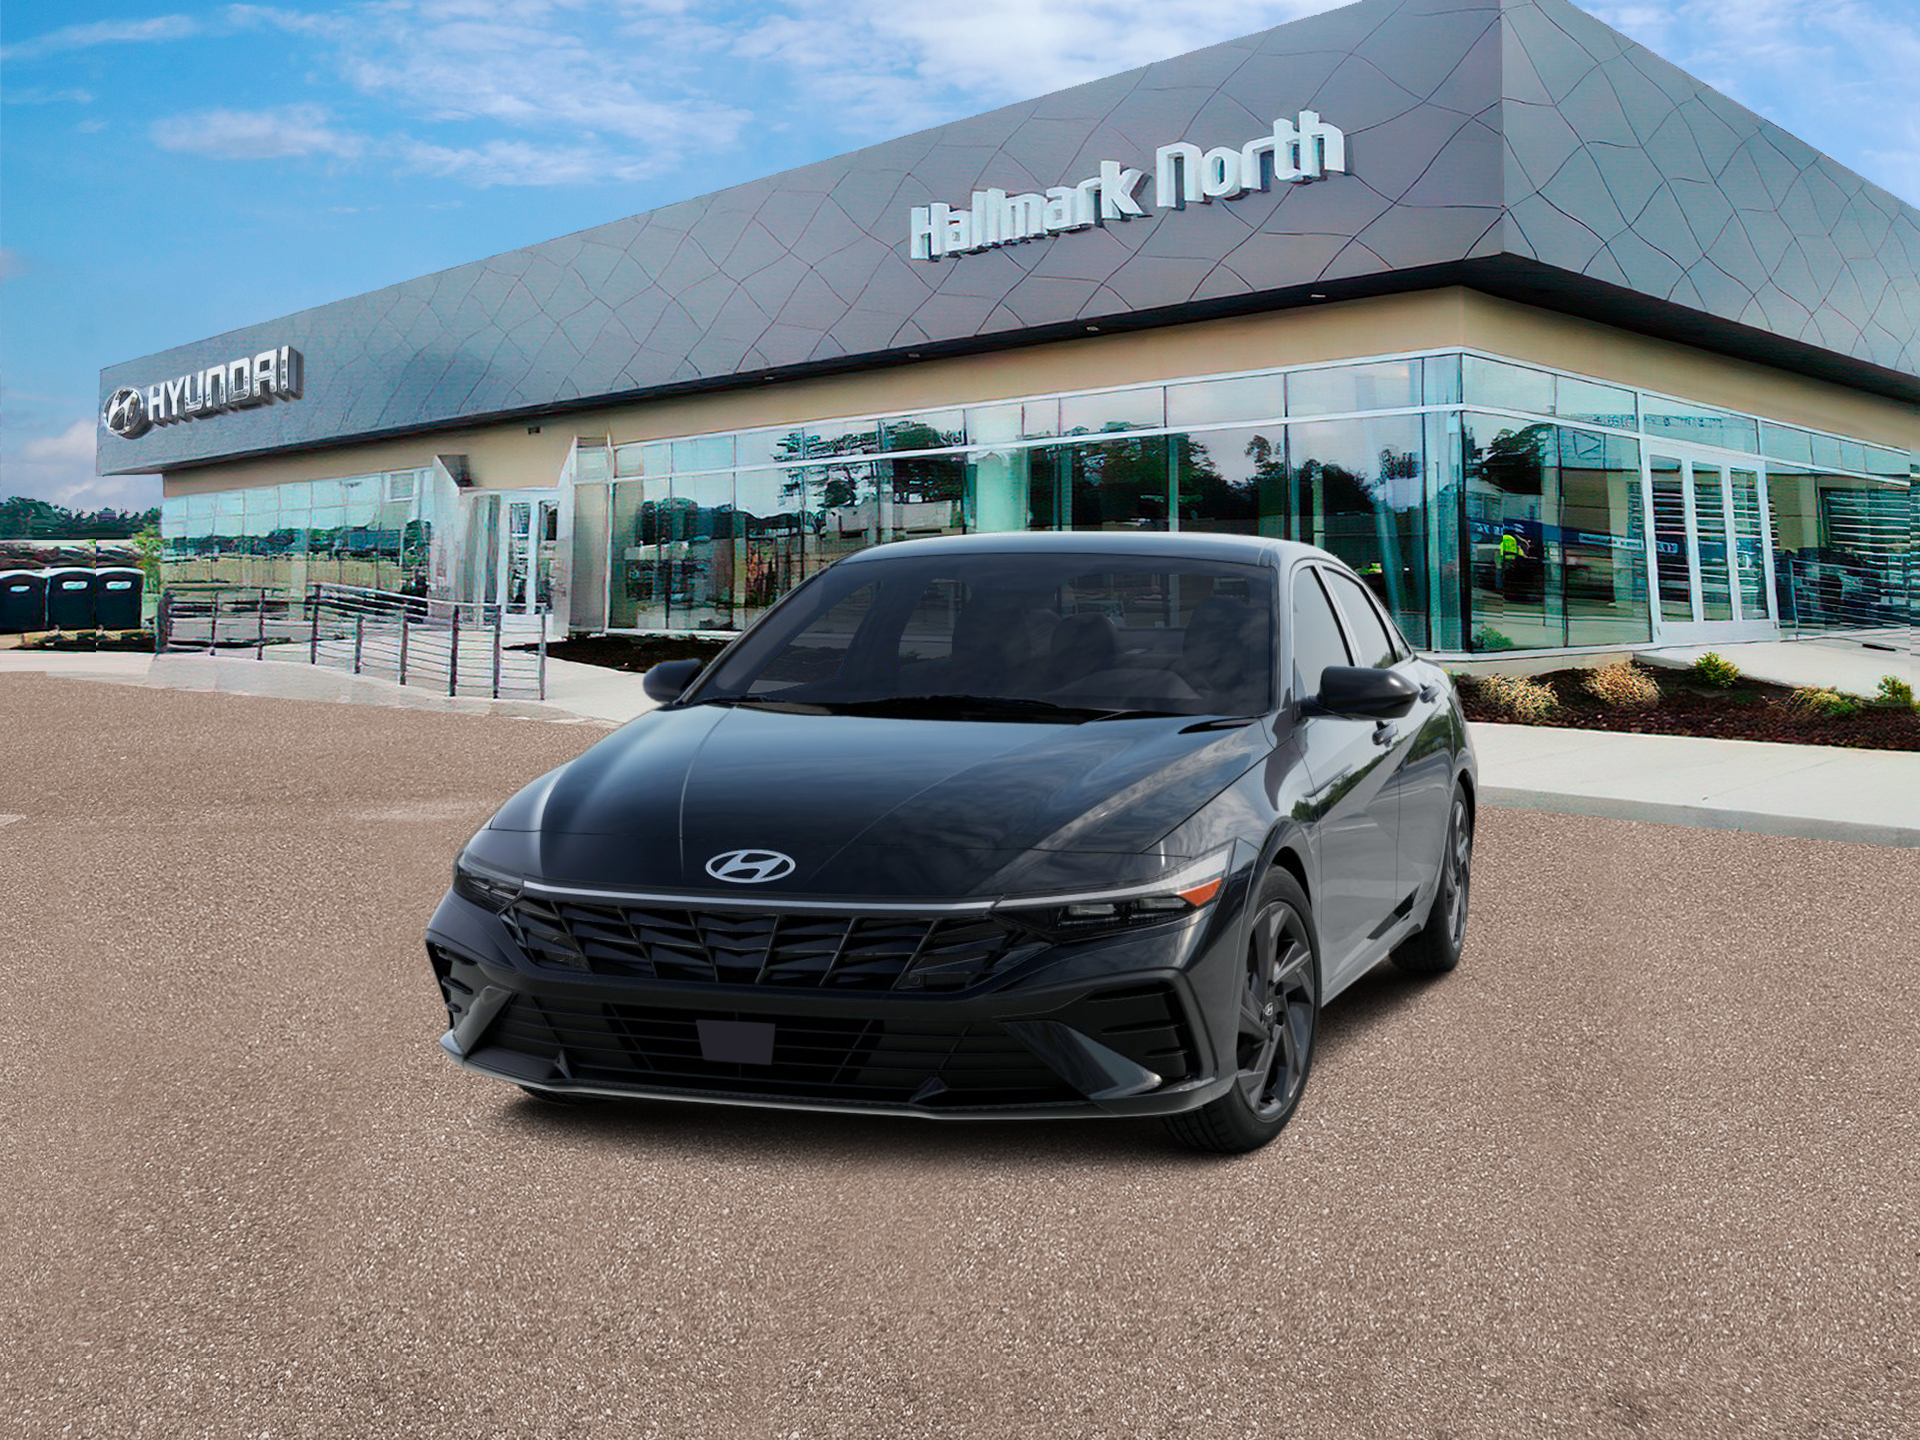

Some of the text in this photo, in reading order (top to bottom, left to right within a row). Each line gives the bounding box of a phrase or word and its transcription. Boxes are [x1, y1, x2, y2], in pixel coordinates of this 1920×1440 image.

[911, 109, 1346, 261] Hallmark North
[149, 345, 292, 422] HYUNDAI
